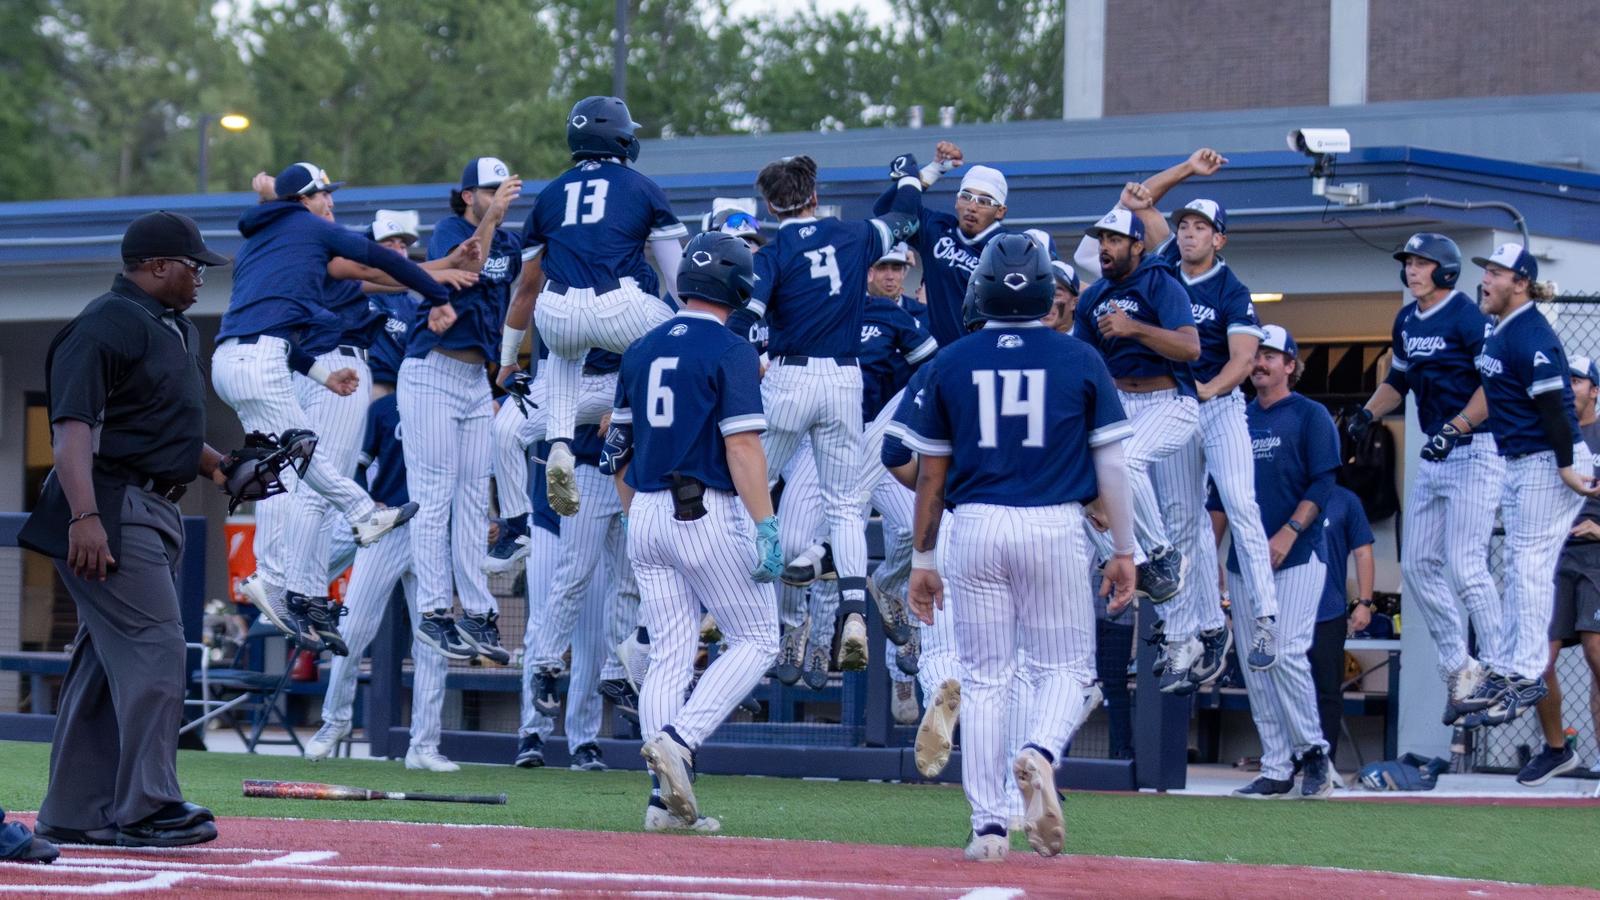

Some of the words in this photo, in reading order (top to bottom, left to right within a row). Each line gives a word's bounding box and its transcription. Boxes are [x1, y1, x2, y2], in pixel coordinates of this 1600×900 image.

[561, 178, 610, 227] 13
[803, 244, 843, 296] 4
[933, 236, 981, 275] Ospre
[646, 356, 680, 427] 6
[971, 368, 1047, 448] 14
